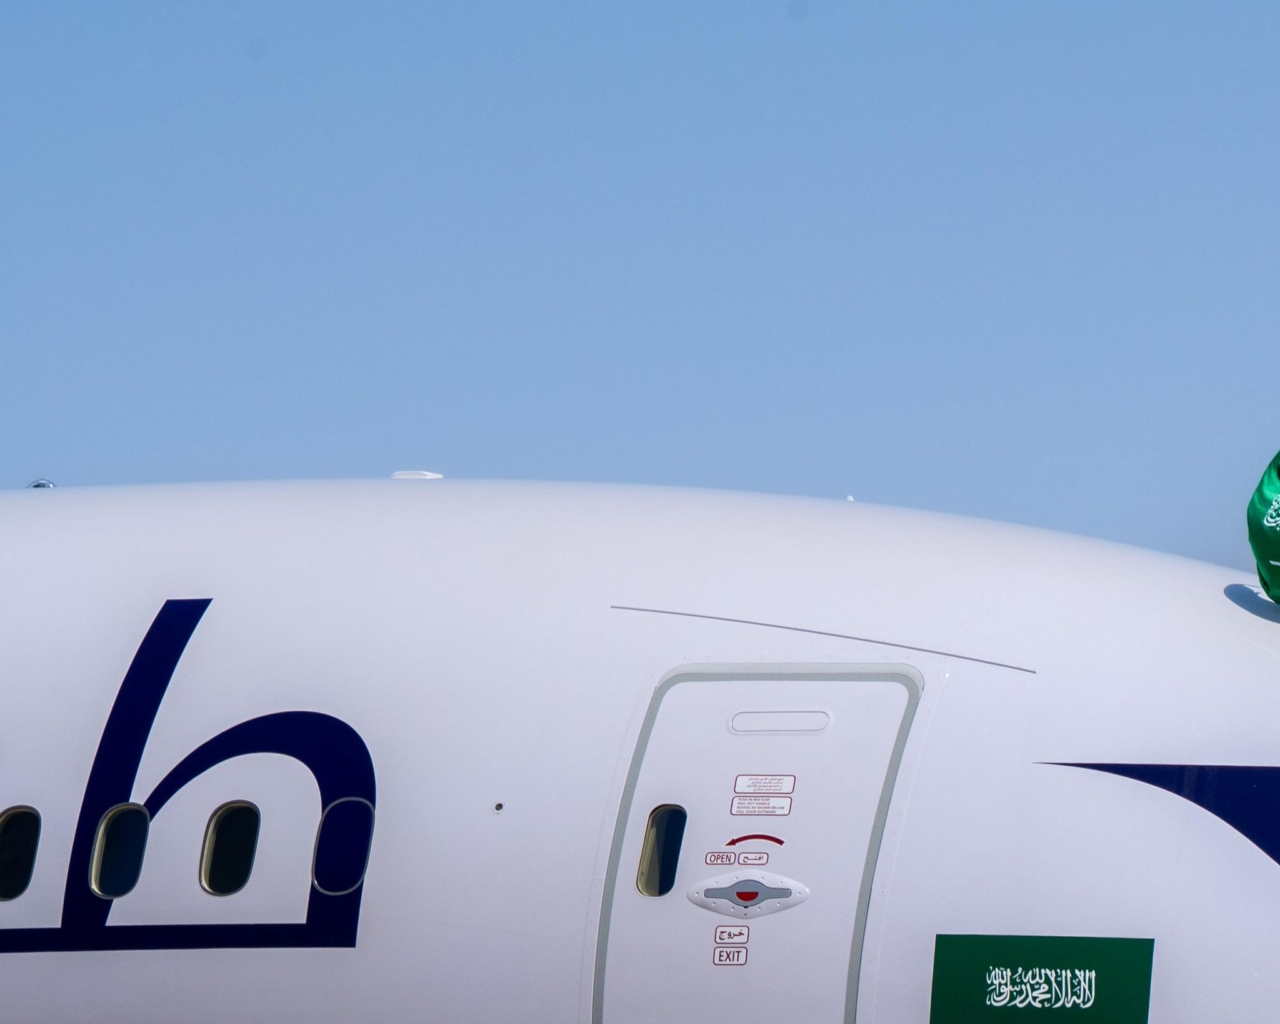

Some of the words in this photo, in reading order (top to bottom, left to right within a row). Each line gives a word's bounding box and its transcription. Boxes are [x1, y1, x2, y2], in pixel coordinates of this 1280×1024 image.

[709, 854, 732, 863] OPEN
[719, 929, 745, 941] خروج
[718, 950, 742, 962] EXIT
